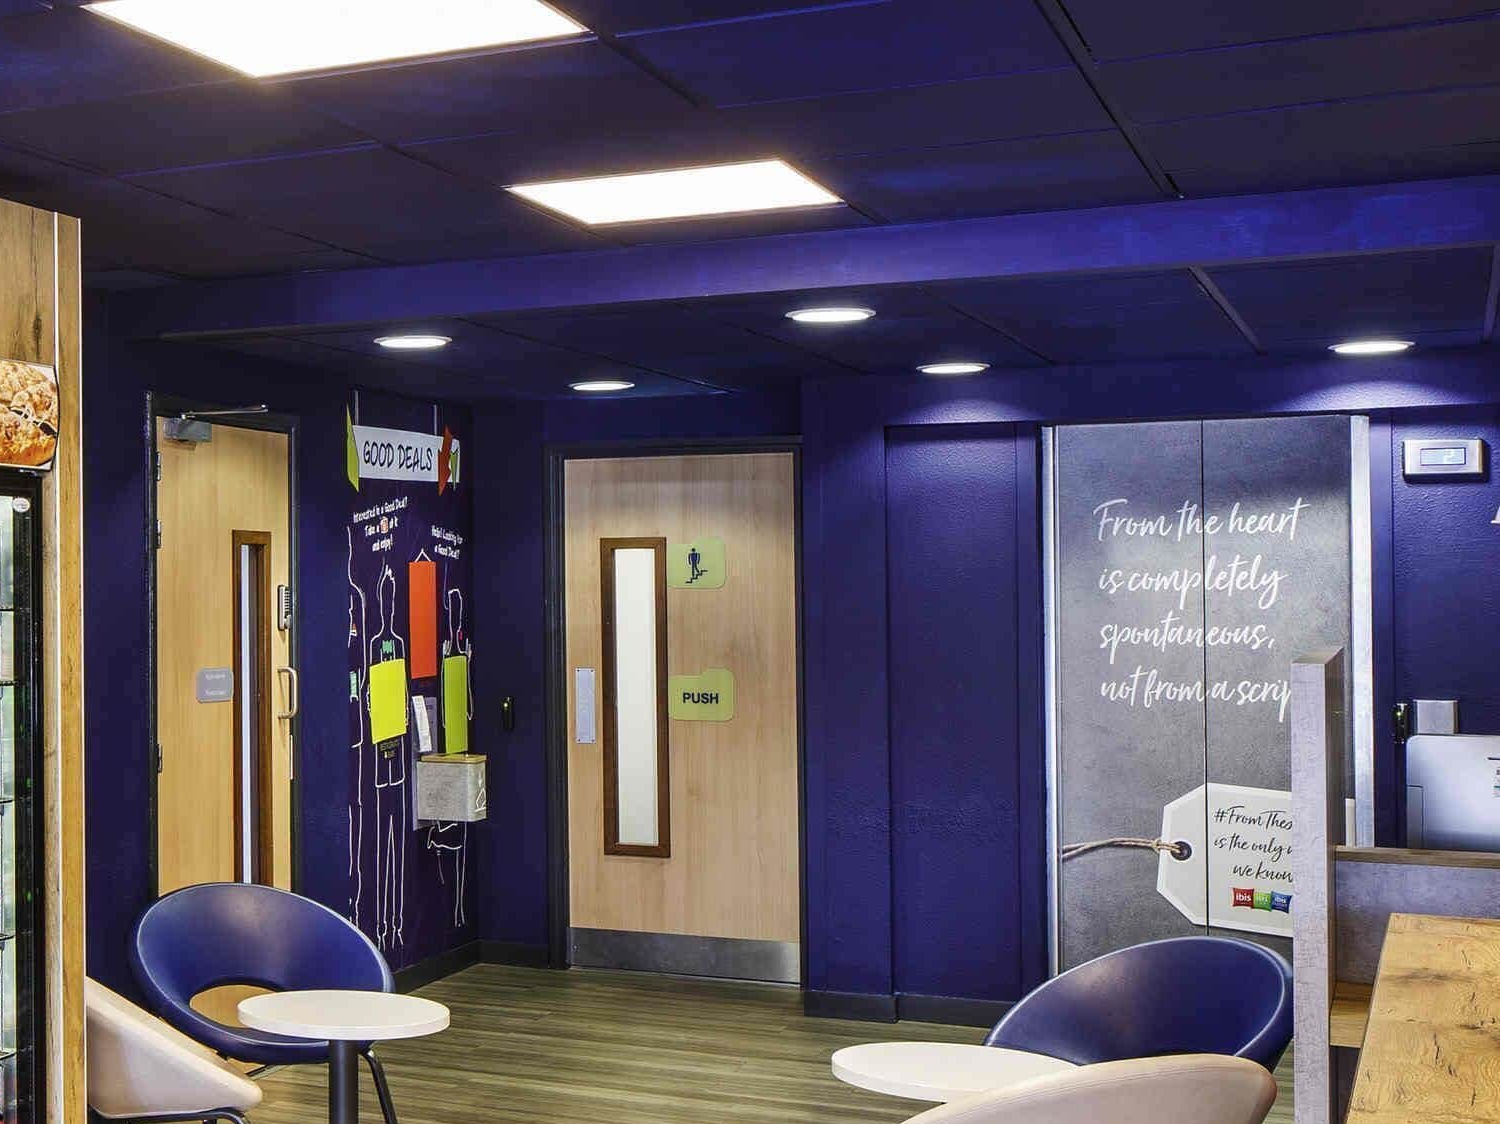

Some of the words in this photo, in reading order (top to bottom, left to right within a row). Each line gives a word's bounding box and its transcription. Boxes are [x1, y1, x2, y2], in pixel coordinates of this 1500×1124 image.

[363, 441, 395, 468] GOOD
[397, 444, 433, 473] DEALS
[1093, 498, 1173, 541] From
[1177, 500, 1224, 542] the
[1228, 497, 1311, 541] heart
[1099, 568, 1124, 594] is
[1128, 554, 1289, 610] completely
[1100, 610, 1276, 665] spontaneous,
[682, 692, 719, 704] PUSH
[1101, 665, 1149, 707] not
[1144, 669, 1209, 708] from
[1211, 679, 1236, 701] a
[1236, 679, 1292, 723] scrip
[1214, 837, 1227, 849] is
[1228, 833, 1251, 852] the
[1251, 837, 1287, 863] only
[1233, 864, 1254, 877] we
[1235, 893, 1252, 902] ibis
